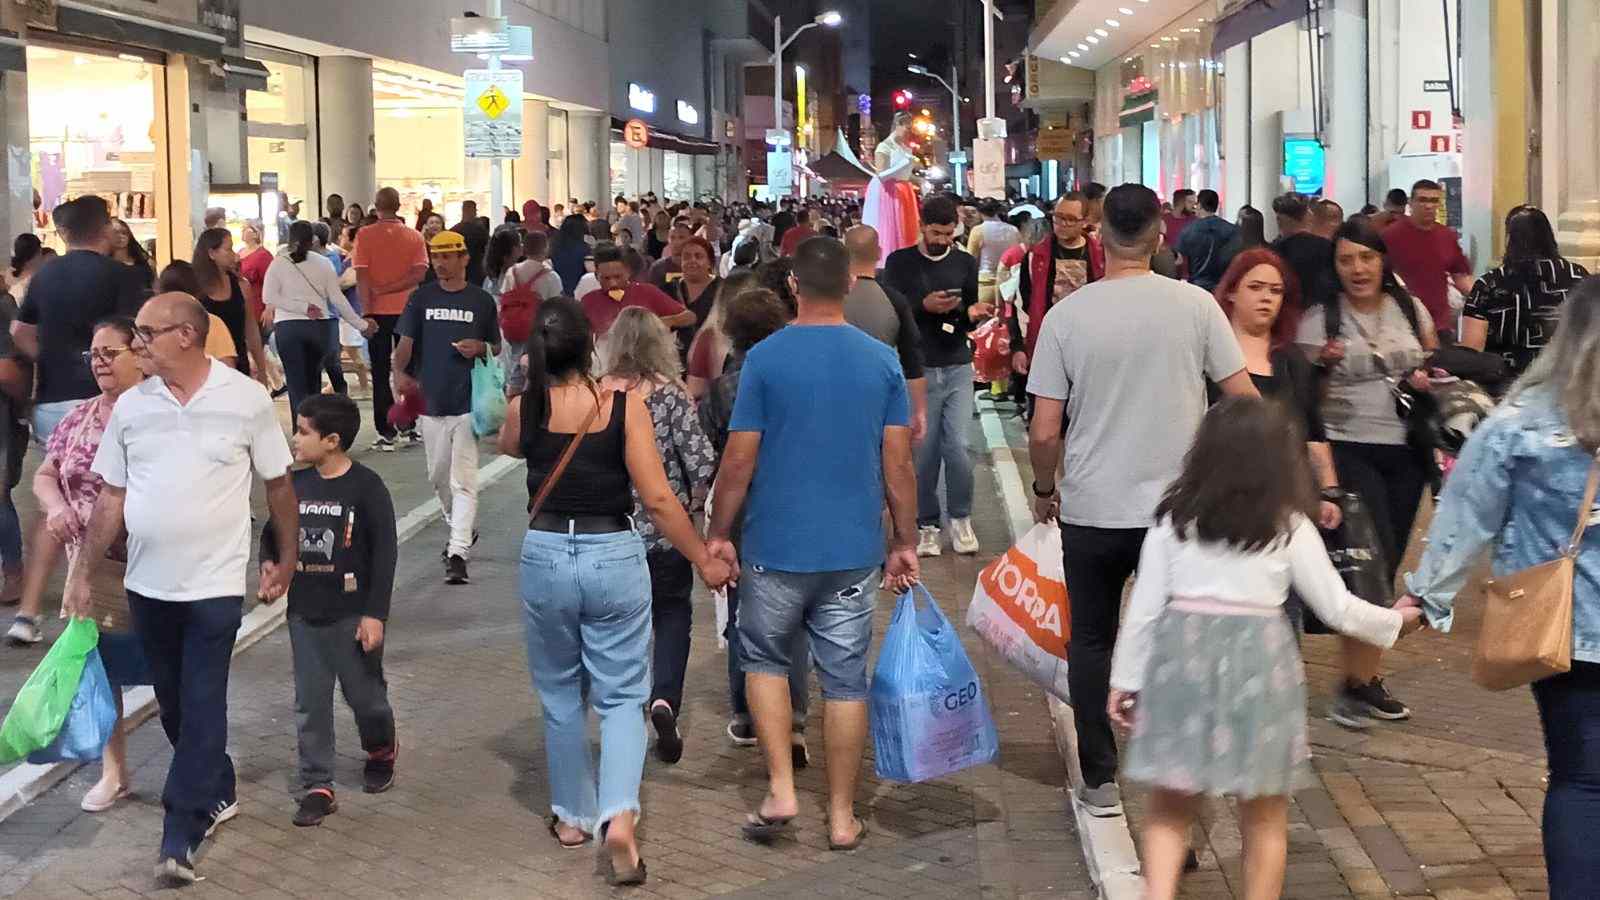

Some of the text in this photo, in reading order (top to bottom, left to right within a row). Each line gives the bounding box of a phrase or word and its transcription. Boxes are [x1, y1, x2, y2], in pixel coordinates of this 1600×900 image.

[425, 308, 474, 323] PEDALO
[990, 552, 1062, 637] TORRA
[944, 681, 977, 710] GEO
